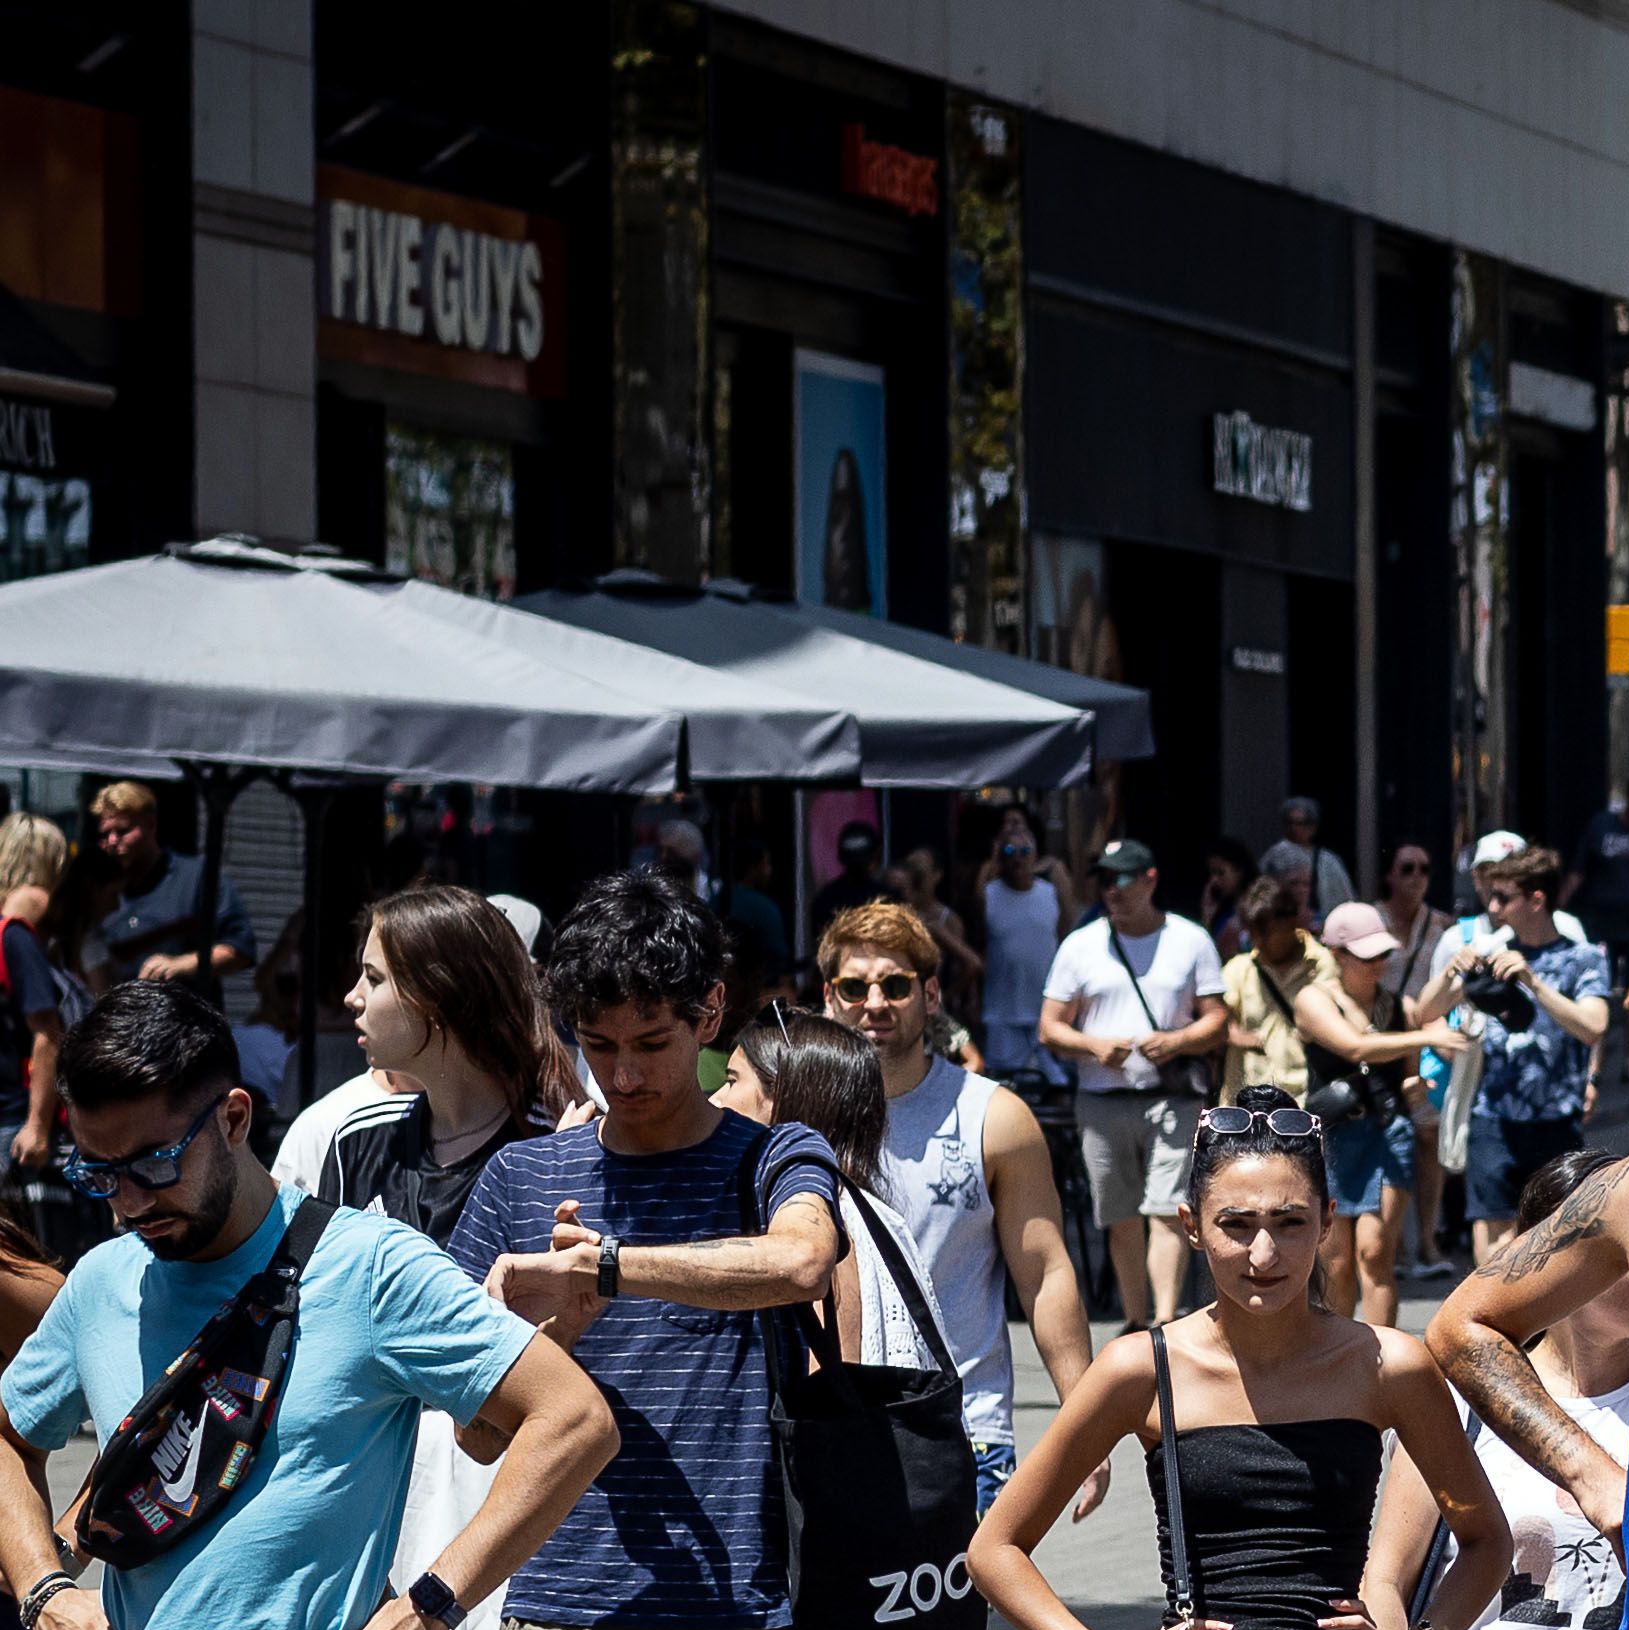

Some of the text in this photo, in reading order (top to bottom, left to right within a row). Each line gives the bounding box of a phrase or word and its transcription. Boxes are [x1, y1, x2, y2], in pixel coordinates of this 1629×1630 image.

[330, 200, 545, 361] FIVE GUYS
[151, 1410, 198, 1481] NIKE
[869, 1552, 974, 1623] ZOO
